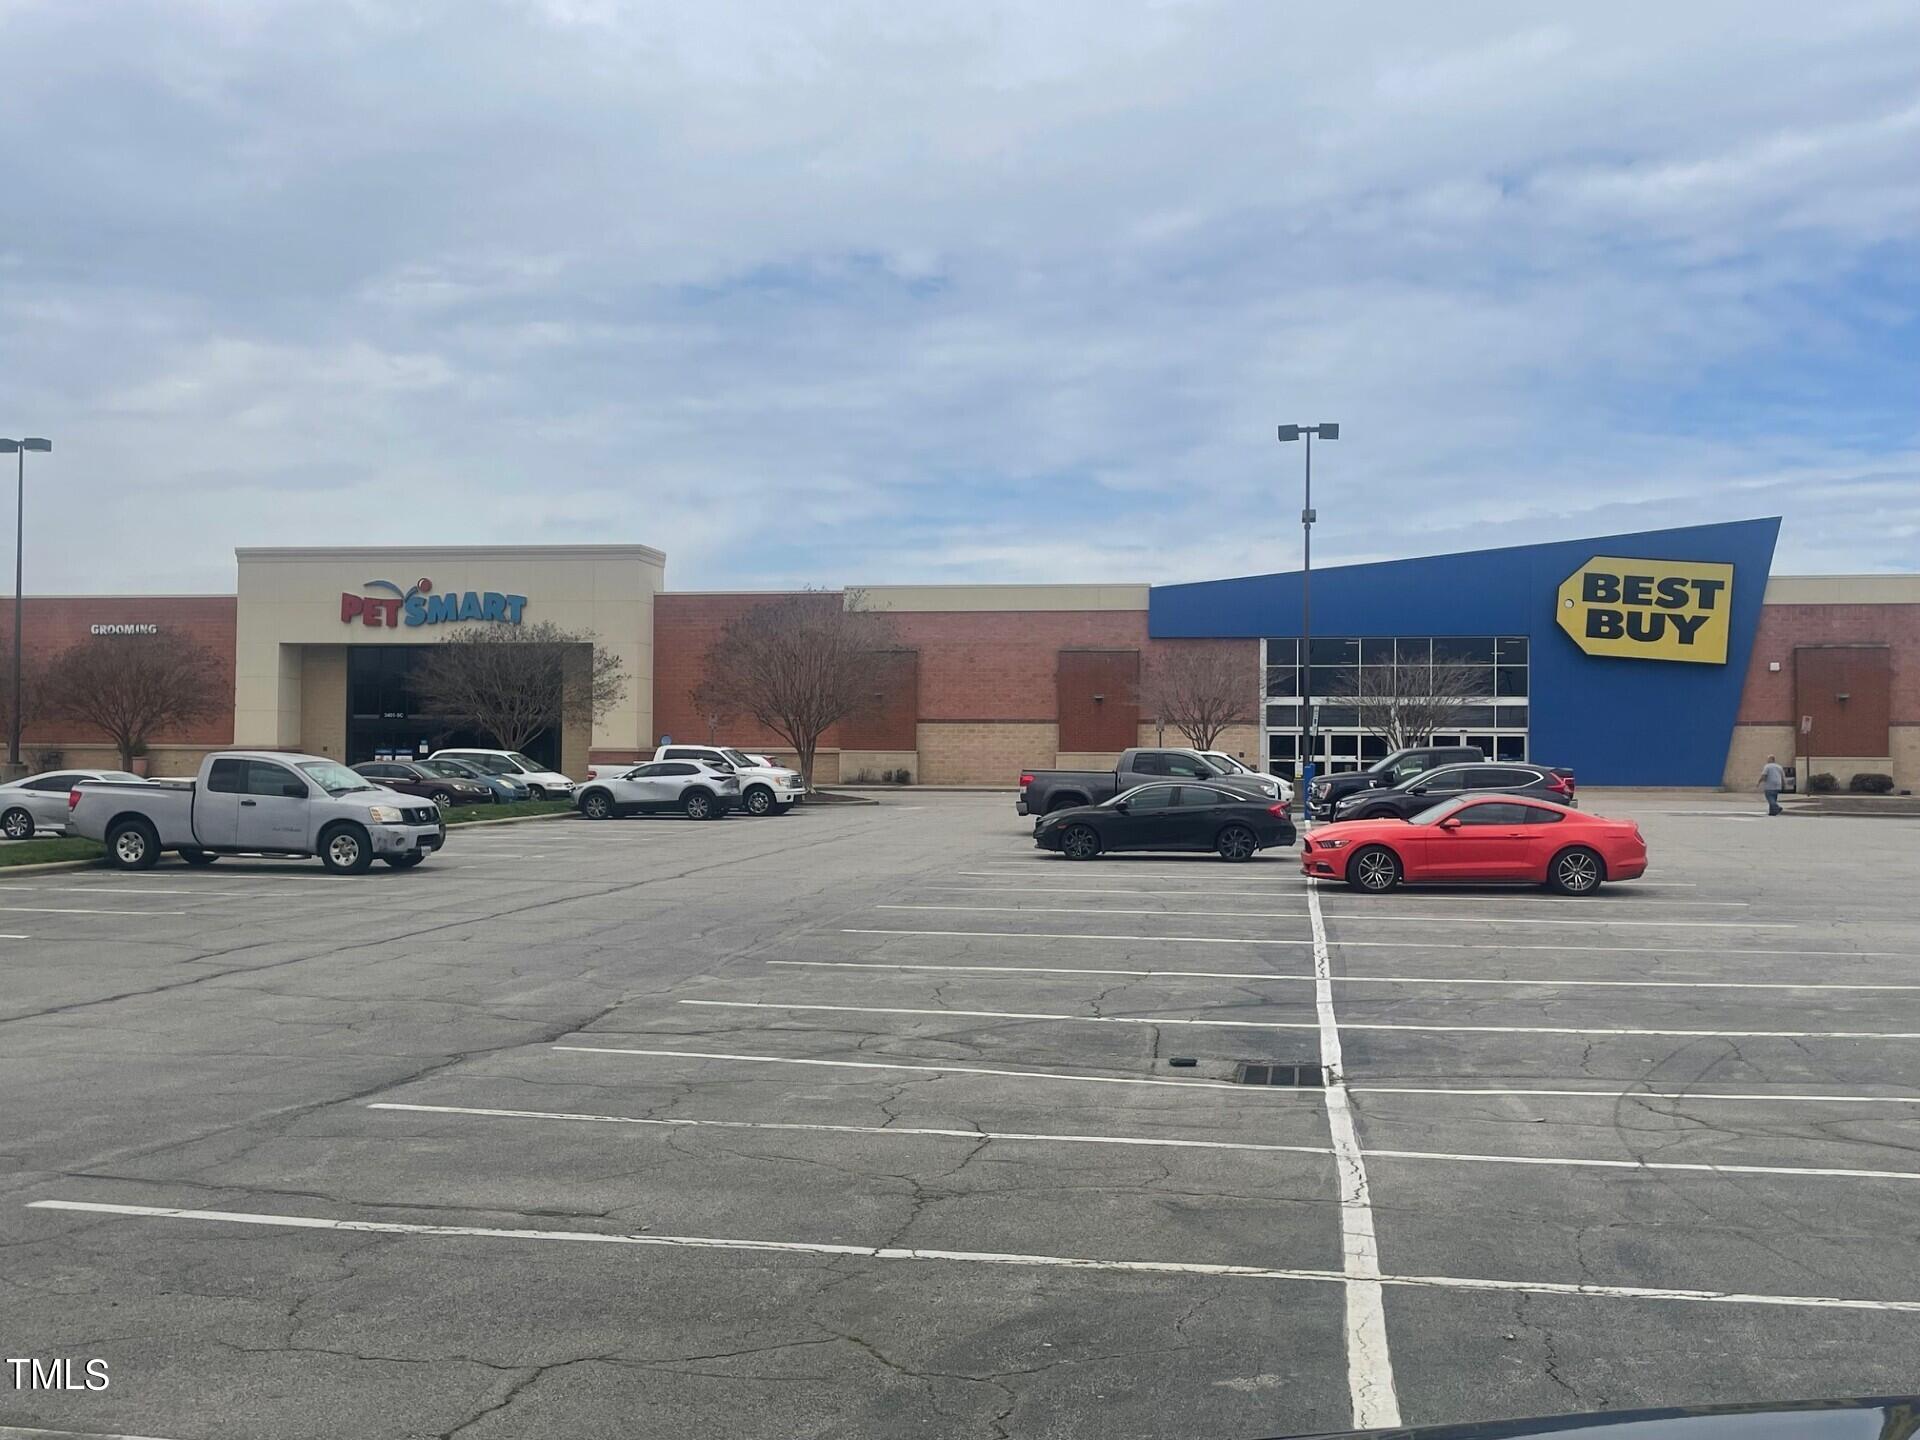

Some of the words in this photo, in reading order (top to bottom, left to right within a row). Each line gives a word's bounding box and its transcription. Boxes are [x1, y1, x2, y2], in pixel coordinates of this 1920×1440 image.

[340, 588, 528, 628] PETSMART
[1582, 573, 1725, 610] BEST
[90, 623, 158, 635] GROOMING
[1586, 608, 1711, 645] BUY
